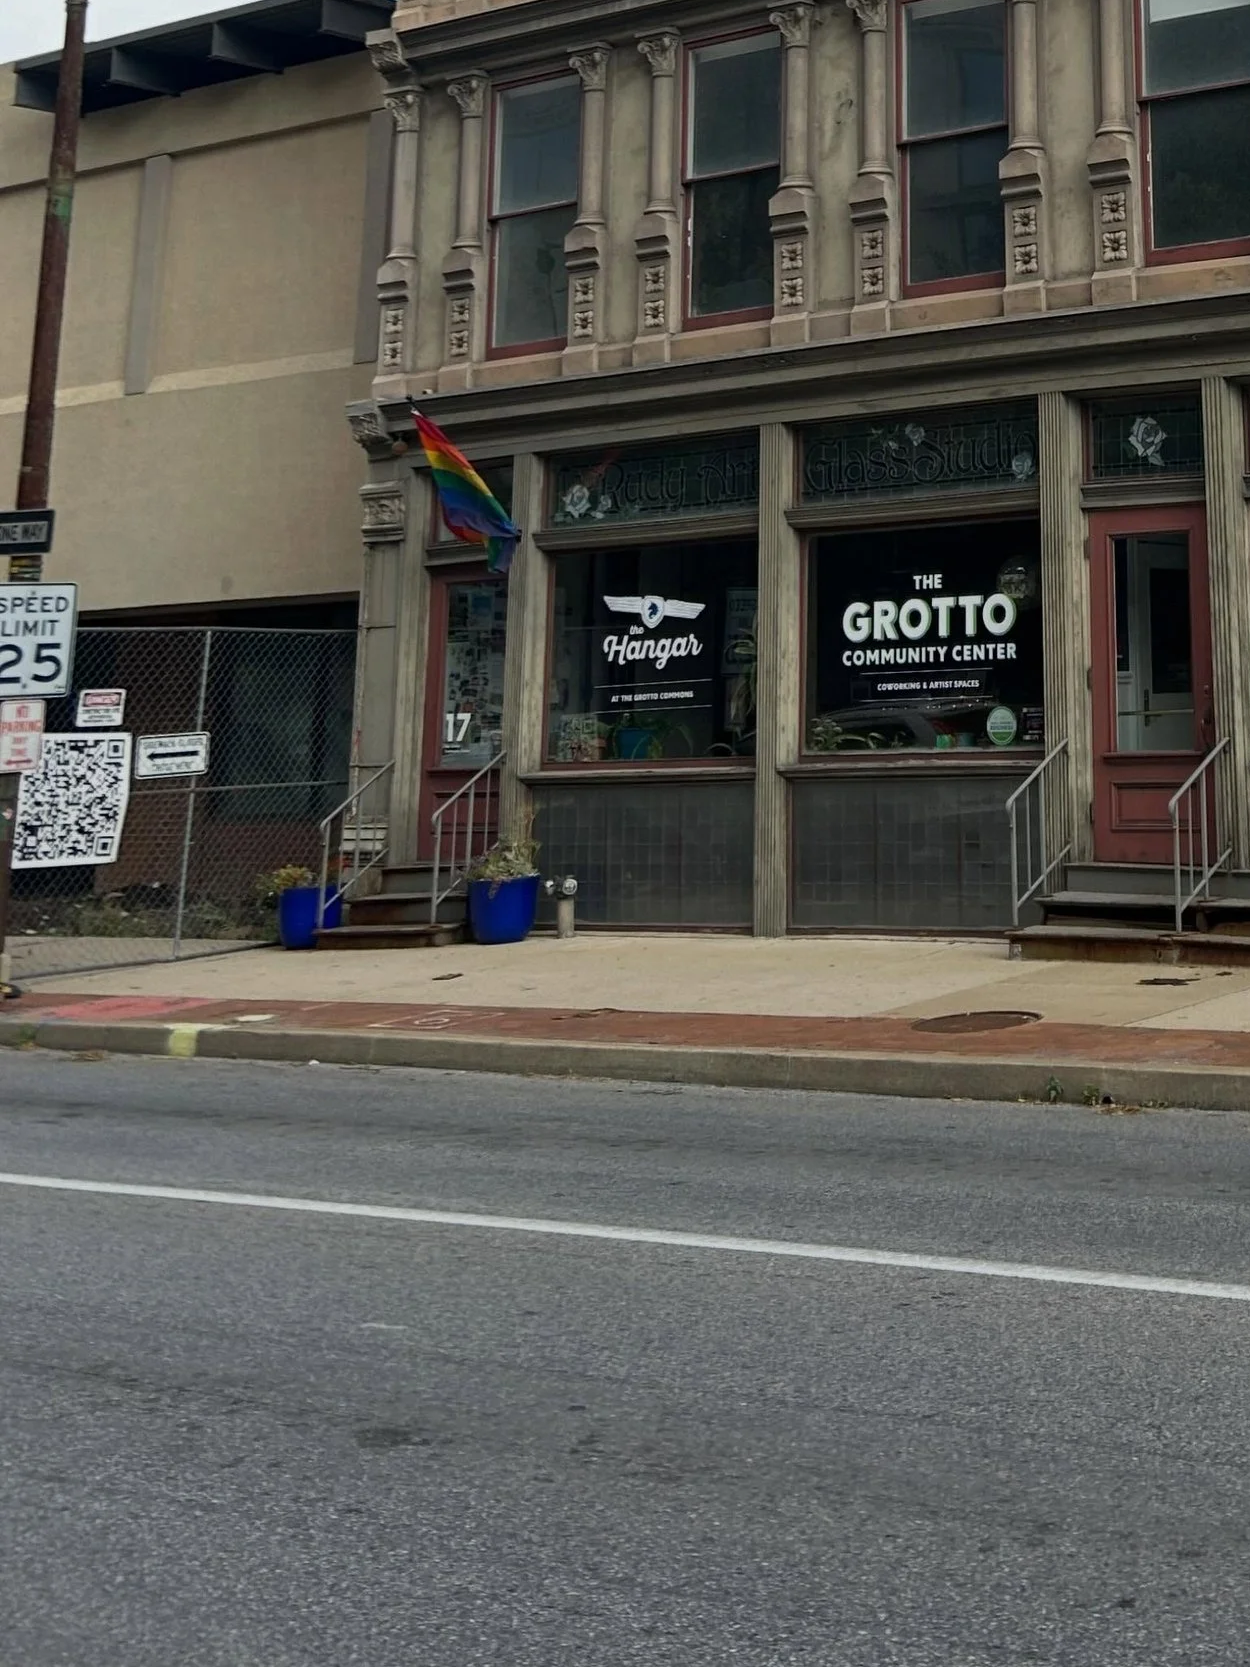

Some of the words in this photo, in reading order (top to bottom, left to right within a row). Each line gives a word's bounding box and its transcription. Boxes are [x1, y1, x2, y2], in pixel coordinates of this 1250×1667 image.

[602, 460, 685, 511] Rudy
[805, 439, 910, 493] Glass
[913, 420, 1036, 483] Studio
[913, 574, 943, 590] THE
[2, 620, 60, 637] LIMIT
[842, 593, 1017, 643] GROTTO
[629, 625, 645, 635] the
[0, 643, 61, 683] 25
[603, 633, 703, 670] Hangar
[842, 645, 948, 666] COMMUNITY
[952, 643, 1017, 661] CENTER
[877, 681, 921, 691] COWORKING
[923, 681, 928, 689] &
[929, 680, 953, 689] ARTIST
[954, 679, 980, 688] SPACES
[611, 695, 620, 703] AT
[621, 694, 633, 702] THE
[634, 693, 659, 701] GROTTO
[660, 691, 694, 700] COMMONS
[446, 713, 471, 742] 17
